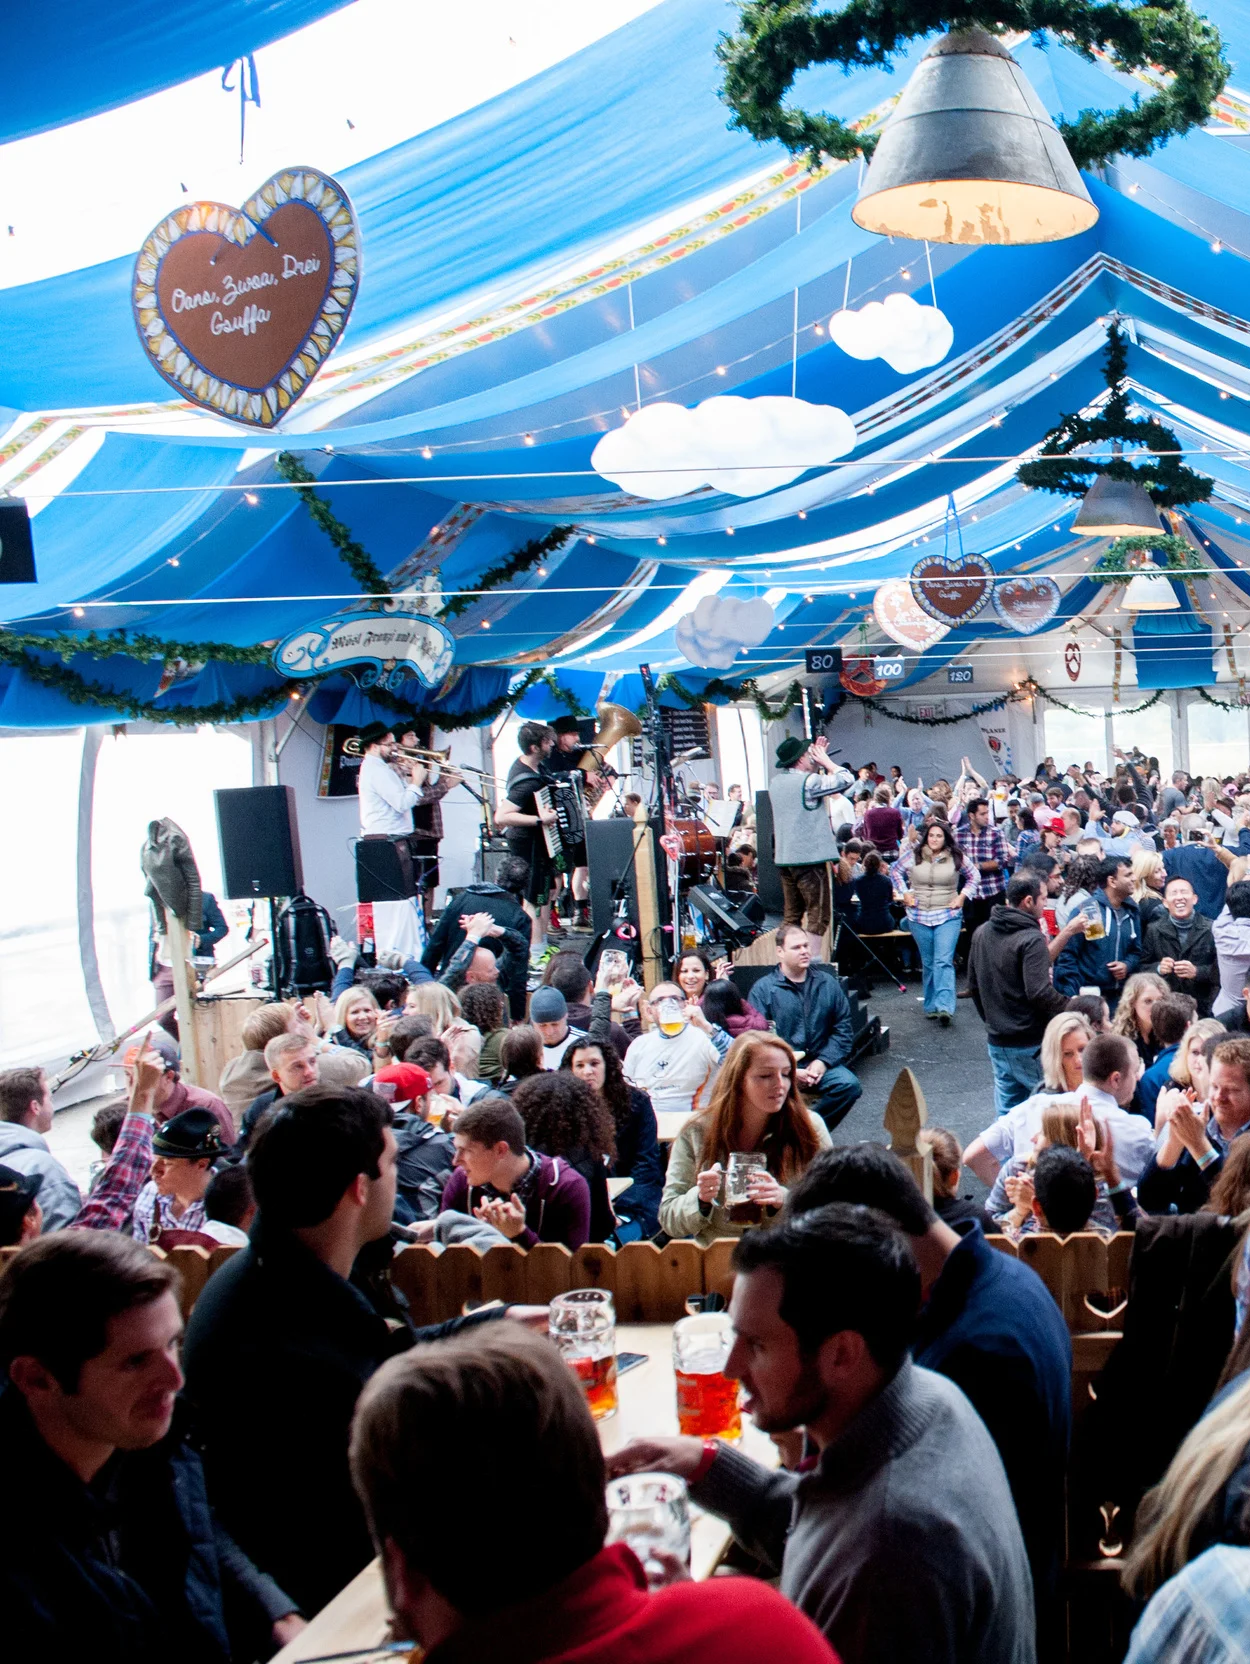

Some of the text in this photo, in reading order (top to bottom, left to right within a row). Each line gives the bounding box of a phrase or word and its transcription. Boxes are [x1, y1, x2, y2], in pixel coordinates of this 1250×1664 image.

[171, 288, 220, 313] Oans,
[281, 252, 321, 280] Drei
[210, 303, 271, 336] Gsuffa
[811, 654, 834, 670] 80
[876, 663, 903, 677] 100
[949, 670, 972, 682] 120
[918, 706, 935, 719] EXIT
